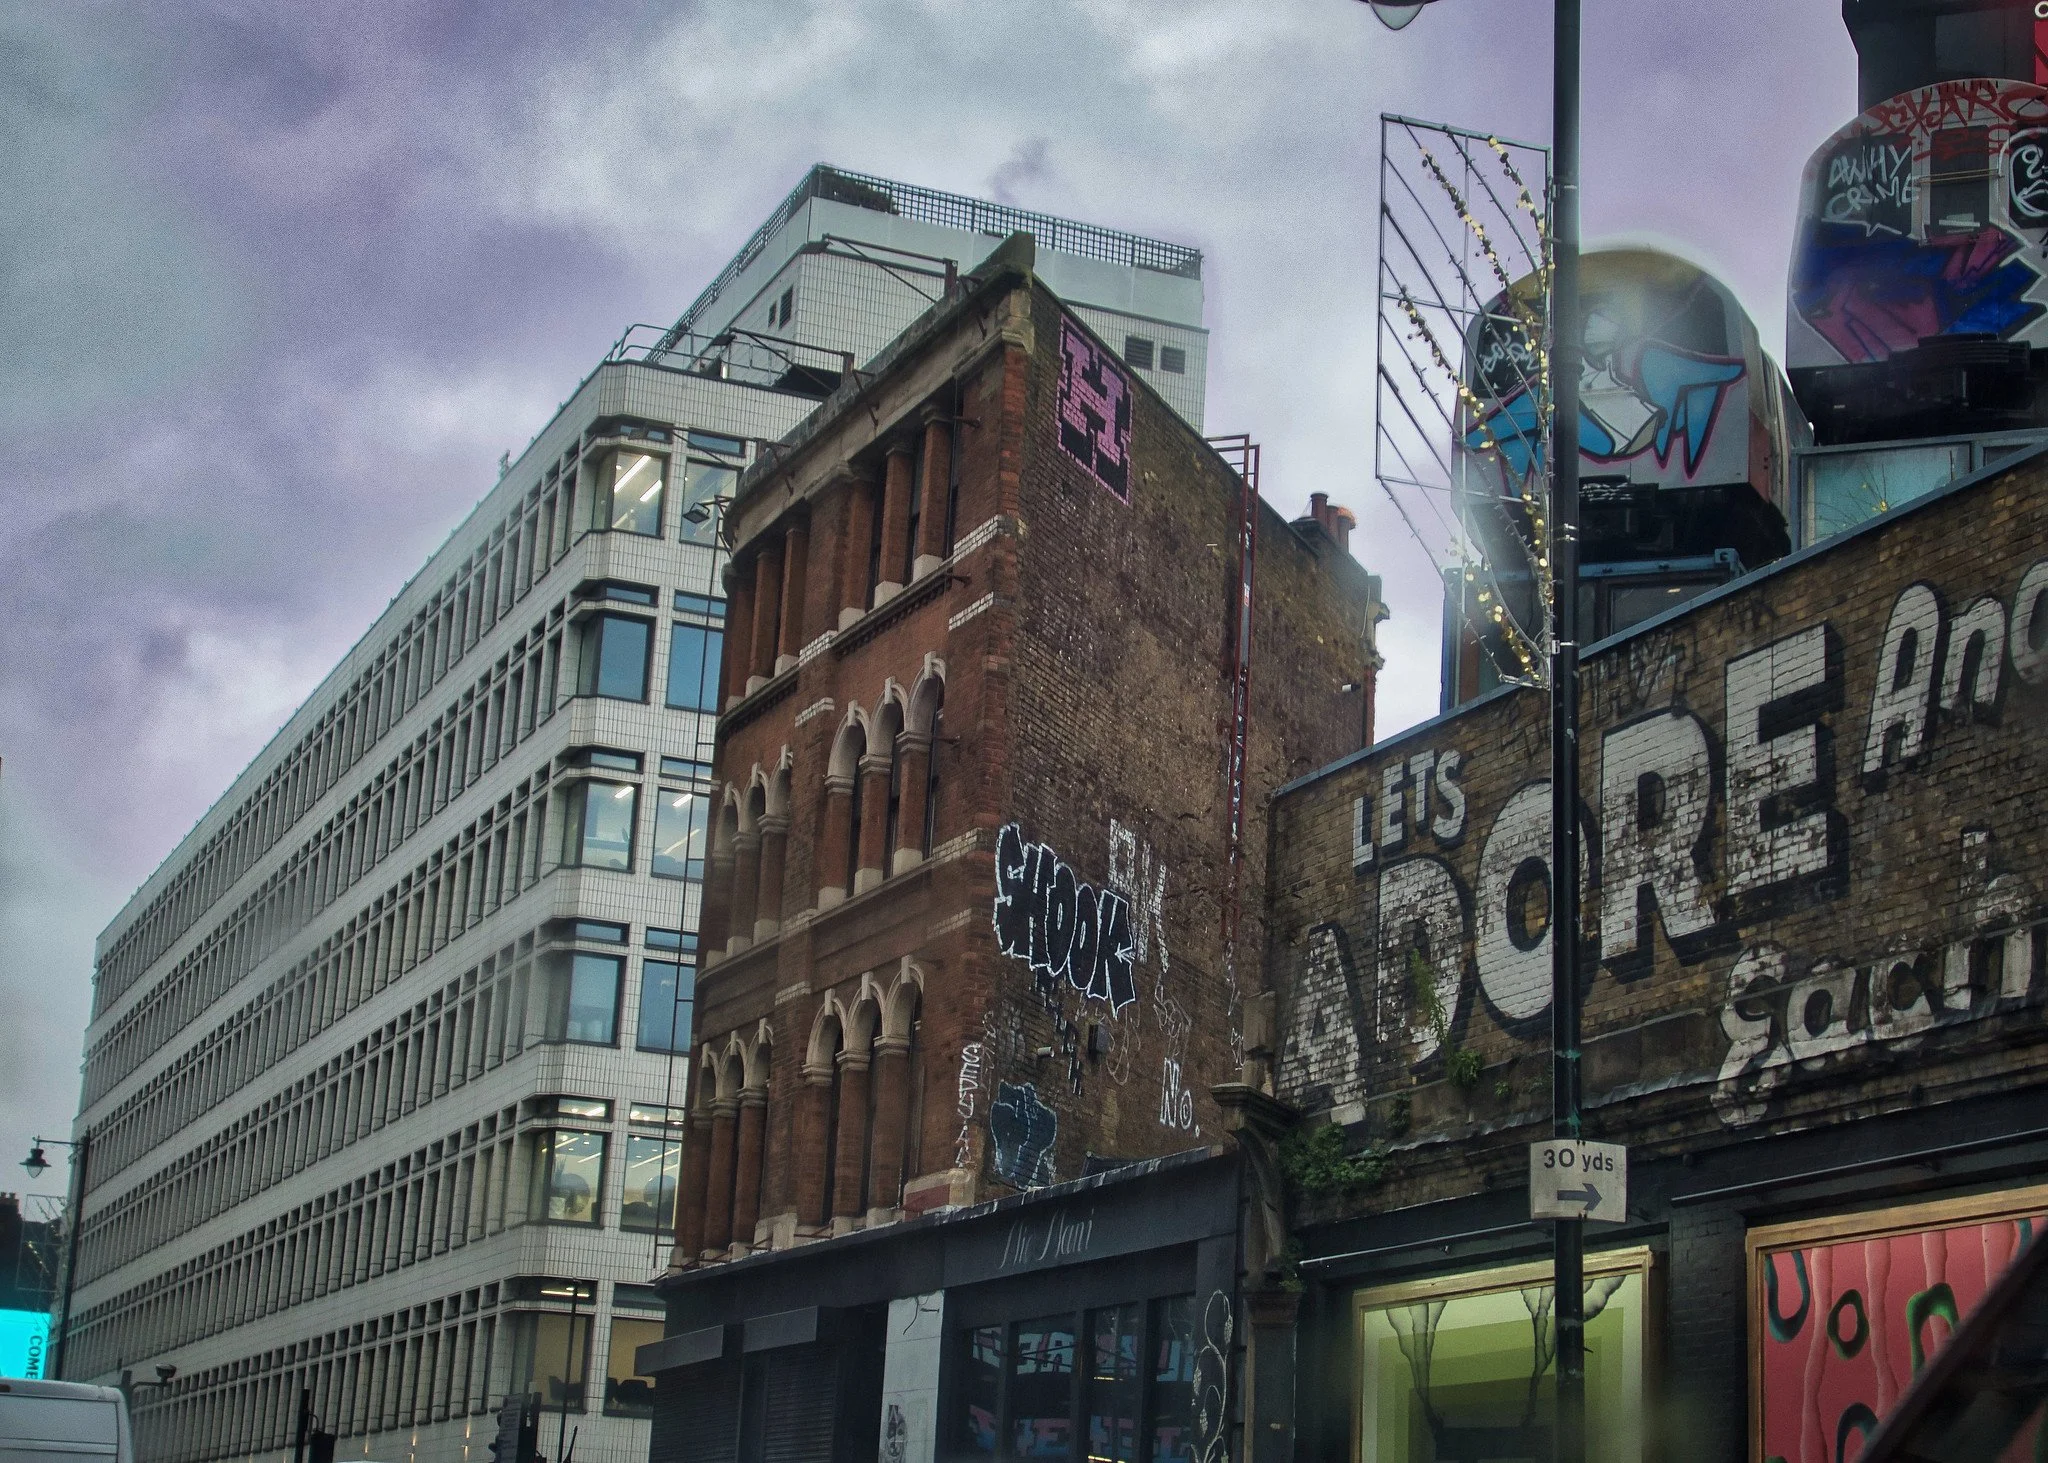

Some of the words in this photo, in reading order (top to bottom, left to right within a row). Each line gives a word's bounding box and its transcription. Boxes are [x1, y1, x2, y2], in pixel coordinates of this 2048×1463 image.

[1352, 749, 1466, 873] LETS
[1275, 622, 1834, 1125] ADORE
[1543, 1147, 1575, 1169] 30
[1581, 1151, 1614, 1173] yds
